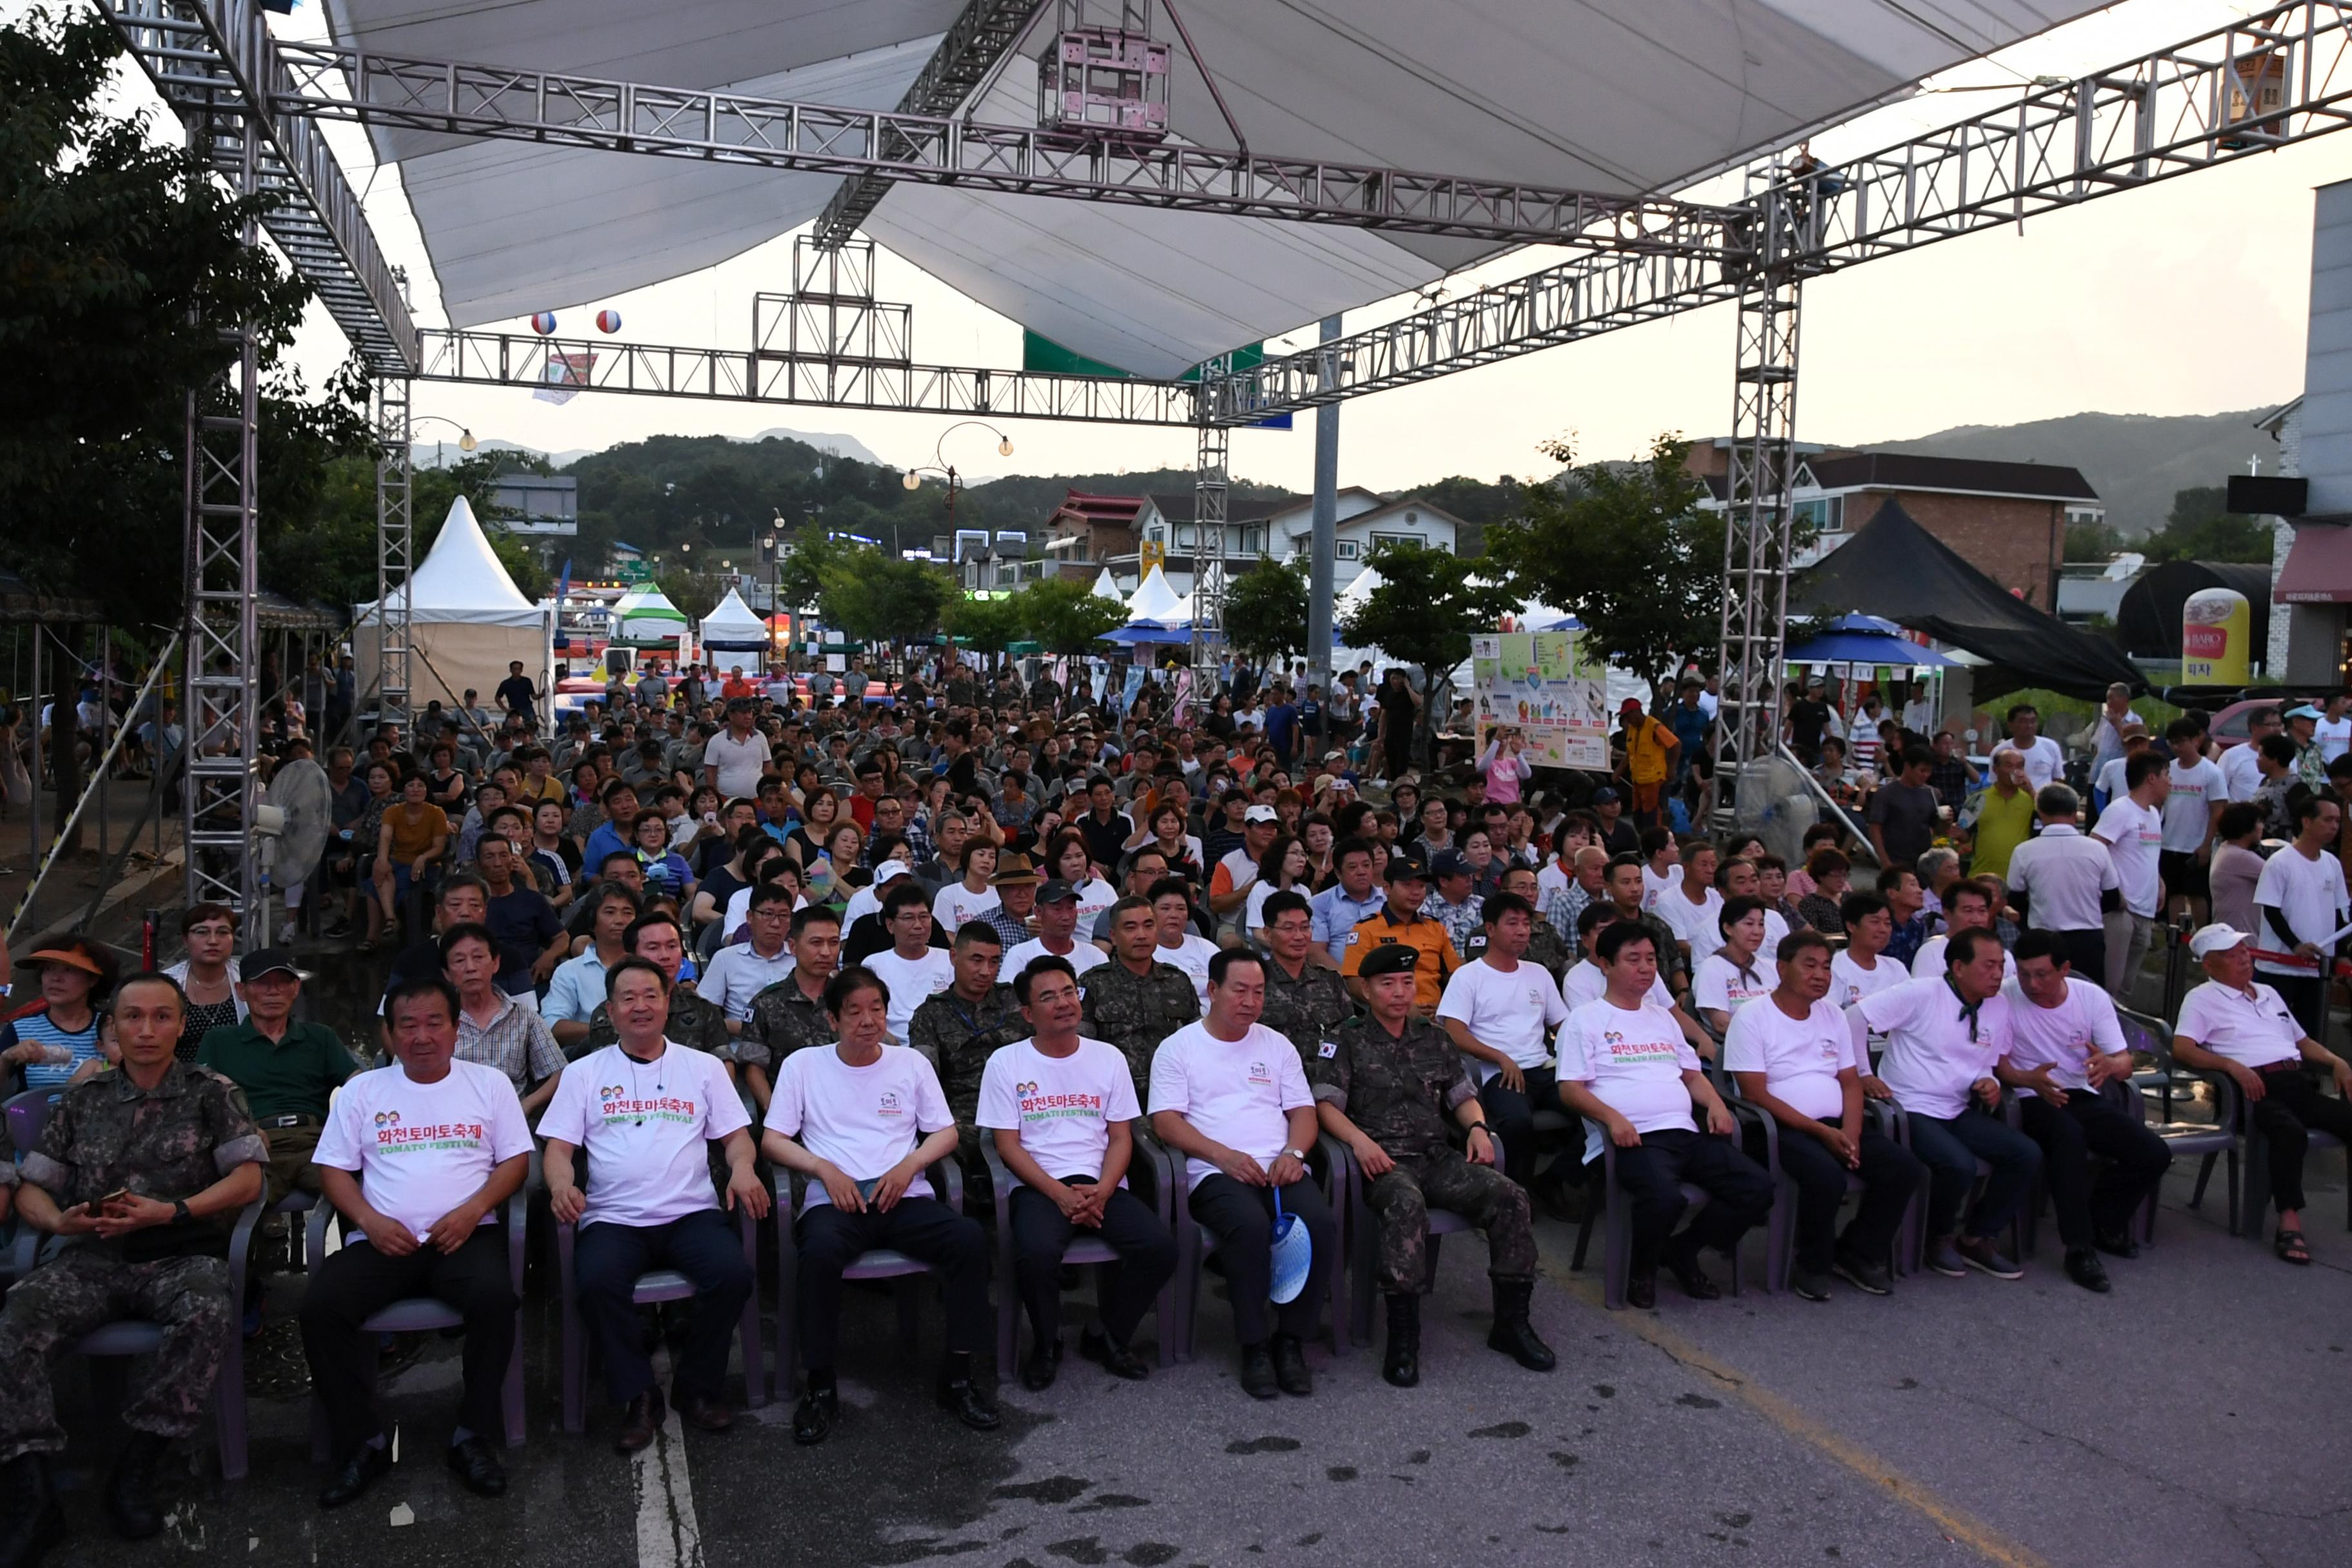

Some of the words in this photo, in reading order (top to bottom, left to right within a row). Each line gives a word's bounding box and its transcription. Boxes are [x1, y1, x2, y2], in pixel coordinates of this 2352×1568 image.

[2188, 663, 2211, 677] 피자
[603, 1097, 694, 1115] 화천토마토축제
[1021, 1093, 1101, 1113] 화천토마토축제
[1023, 1112, 1060, 1122] TOMATO
[1061, 1109, 1100, 1118] FESTIVAL
[377, 1123, 482, 1145] 화천토마토축제
[378, 1143, 426, 1155] TOMATO
[429, 1140, 480, 1150] FESTIVAL
